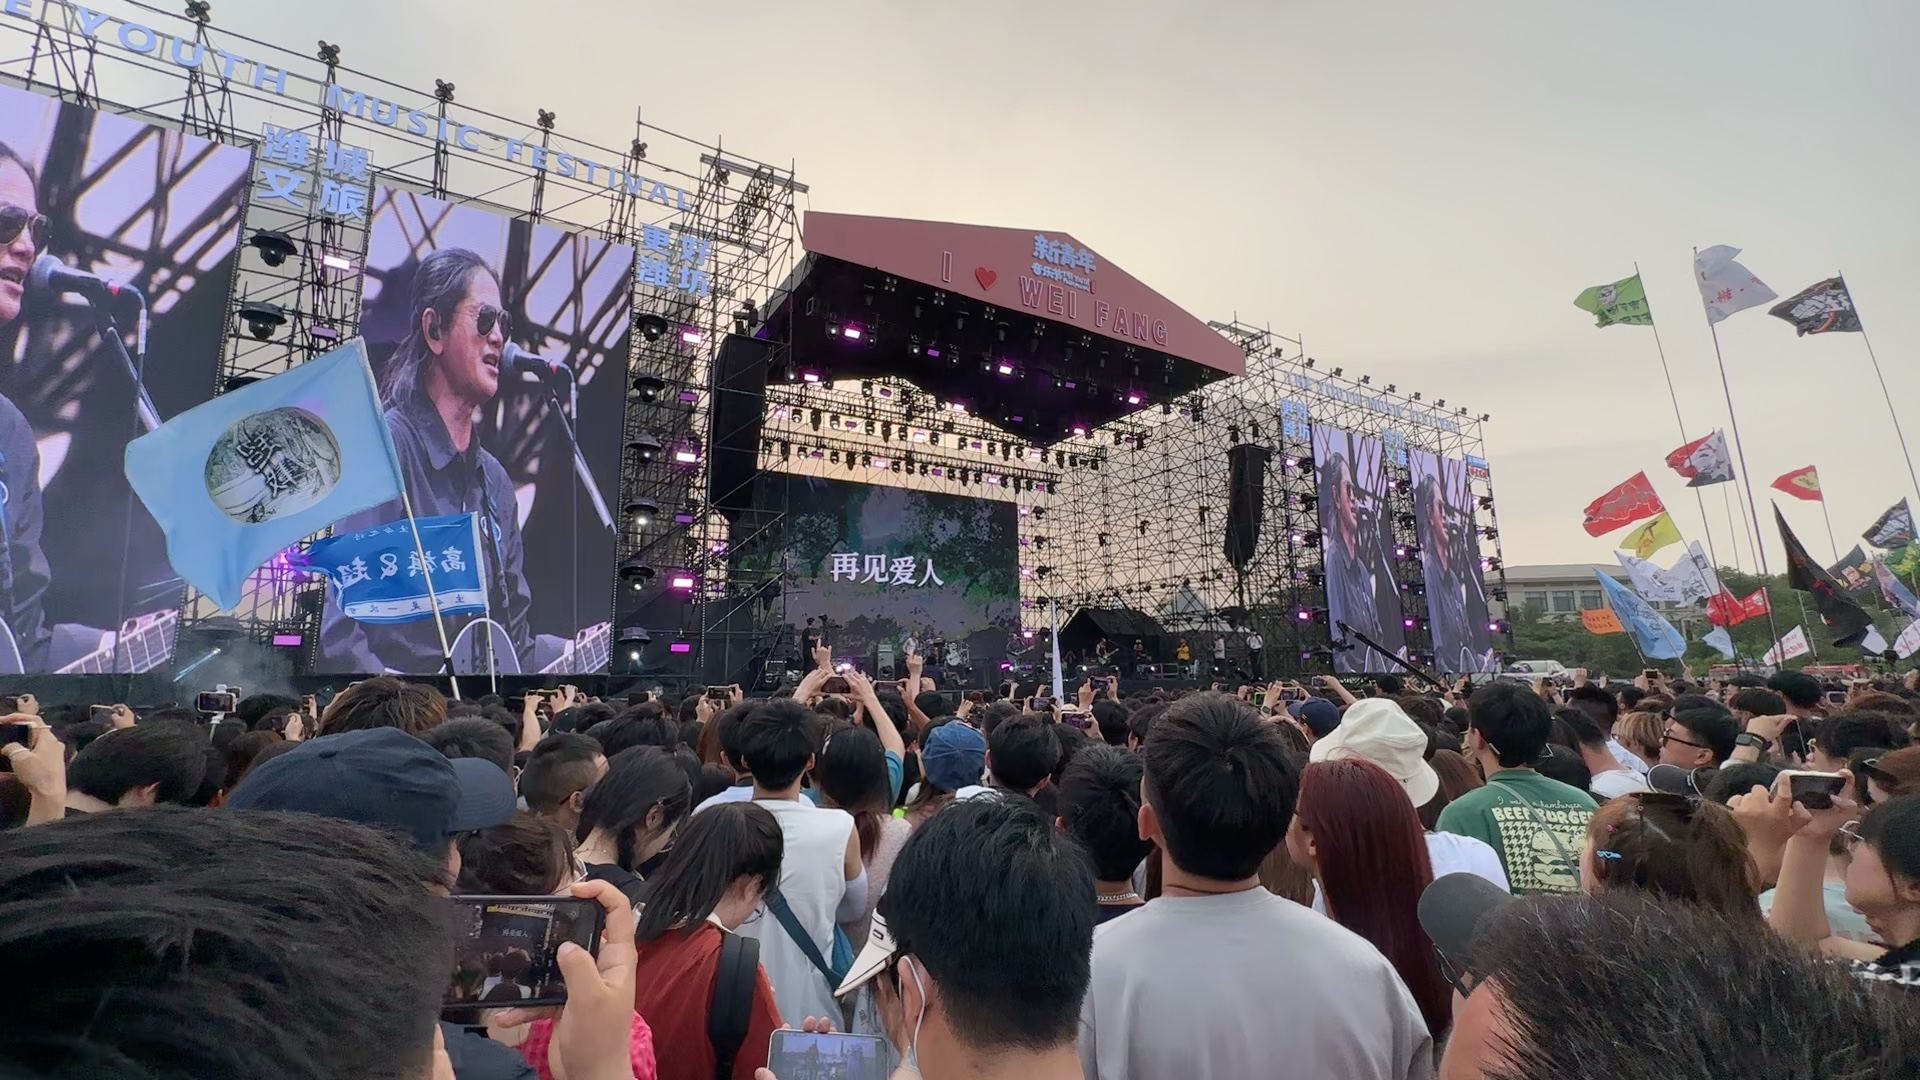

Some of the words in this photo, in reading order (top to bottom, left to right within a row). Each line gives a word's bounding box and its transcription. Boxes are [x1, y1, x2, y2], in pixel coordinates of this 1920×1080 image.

[76, 5, 288, 96] YOUTH
[326, 83, 481, 152] MUSIC
[506, 138, 694, 212] FESTIVAL
[264, 125, 369, 183] 潍城
[257, 169, 366, 221] 文旅
[942, 251, 952, 282] I
[1033, 233, 1096, 274] 新青年
[1020, 275, 1077, 319] WEI
[1095, 300, 1168, 346] FANG
[829, 551, 945, 588] 再见爱人
[1491, 806, 1531, 821] BEEF
